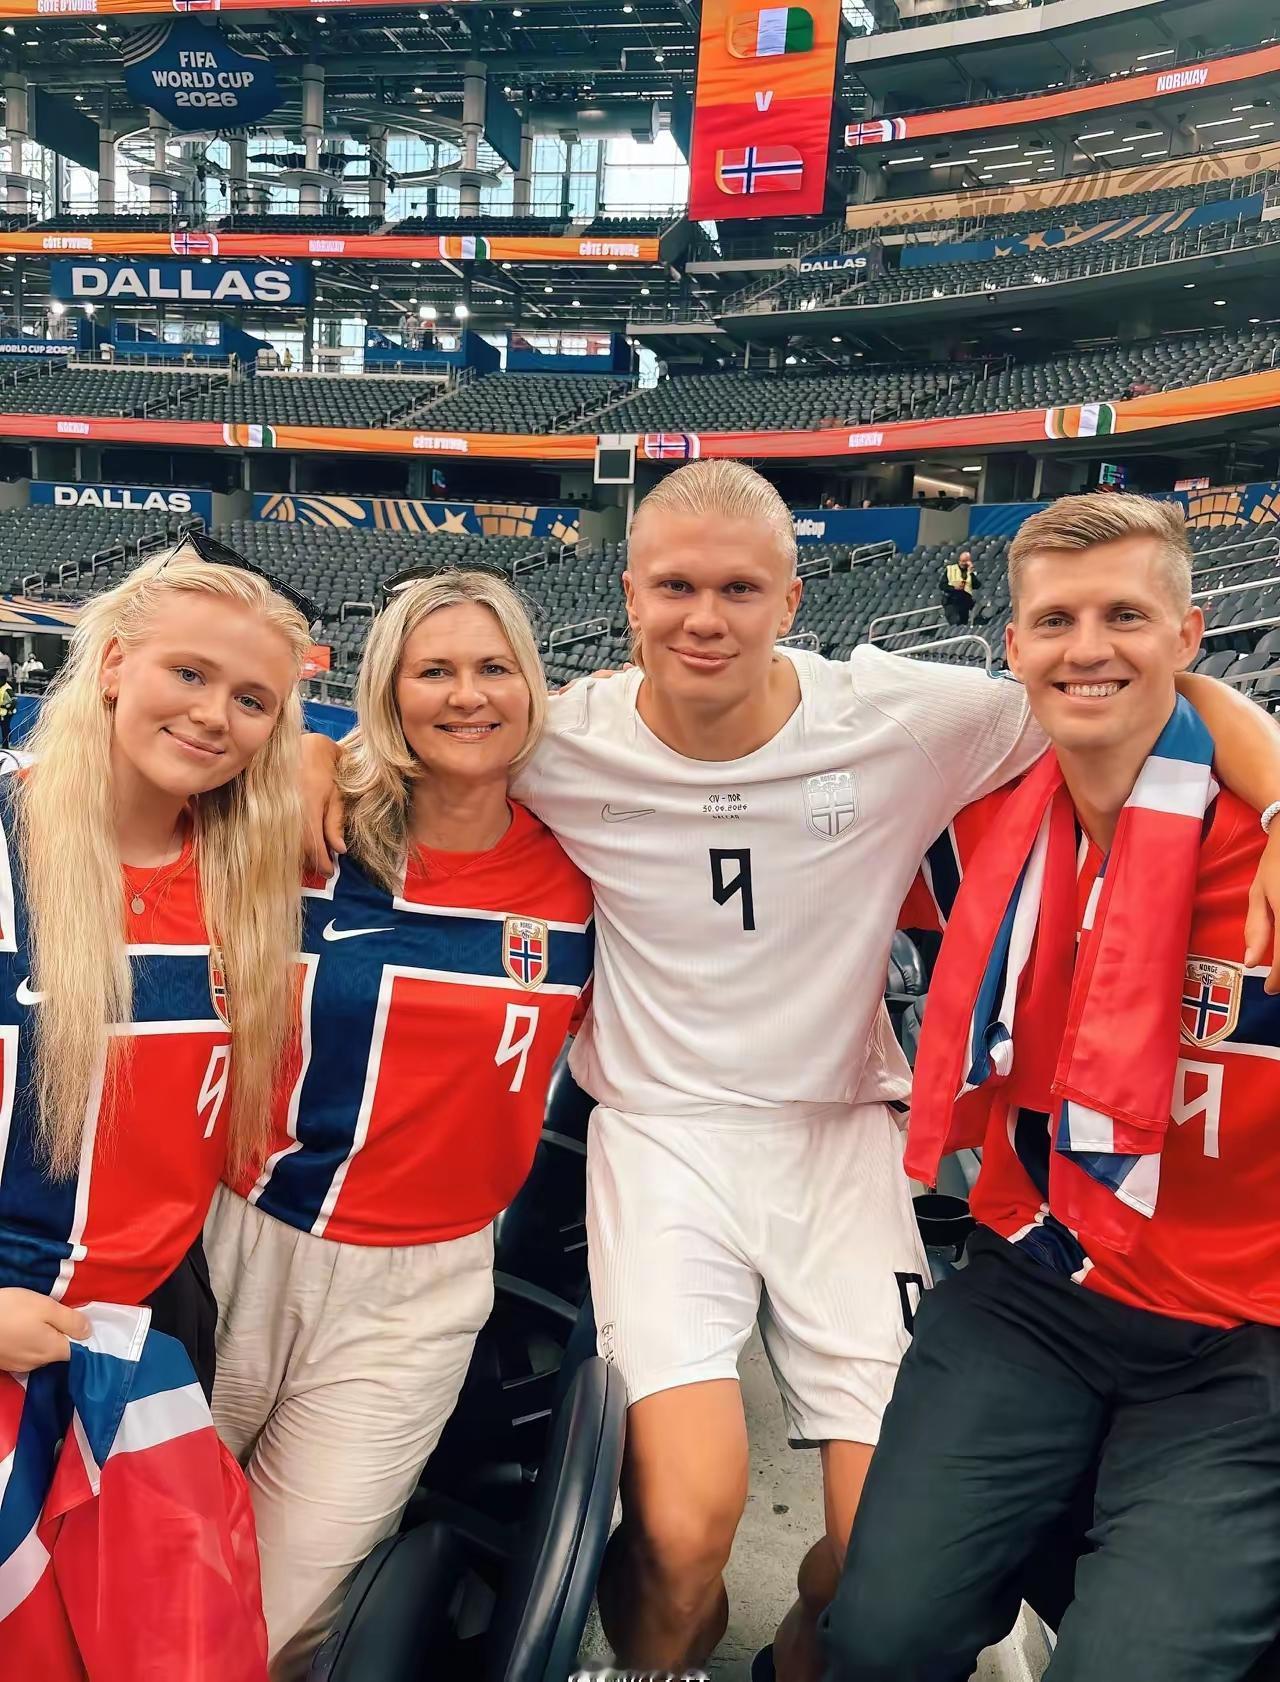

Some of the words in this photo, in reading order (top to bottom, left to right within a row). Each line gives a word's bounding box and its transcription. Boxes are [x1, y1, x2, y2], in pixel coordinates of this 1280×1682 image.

[179, 51, 218, 68] FIFA
[152, 71, 215, 88] WORLD
[217, 72, 254, 88] CUP
[1157, 68, 1208, 92] NORWAY
[175, 91, 238, 107] 2026
[800, 258, 867, 273] DALLAS
[72, 267, 292, 301] DALLAS
[28, 346, 46, 354] CUP
[54, 486, 192, 513] DALLAS
[709, 794, 719, 803] CIV
[708, 847, 756, 931] 9
[1199, 964, 1218, 974] NORGE
[494, 1002, 540, 1093] 9
[197, 1044, 233, 1139] 9
[1170, 1057, 1224, 1159] 9
